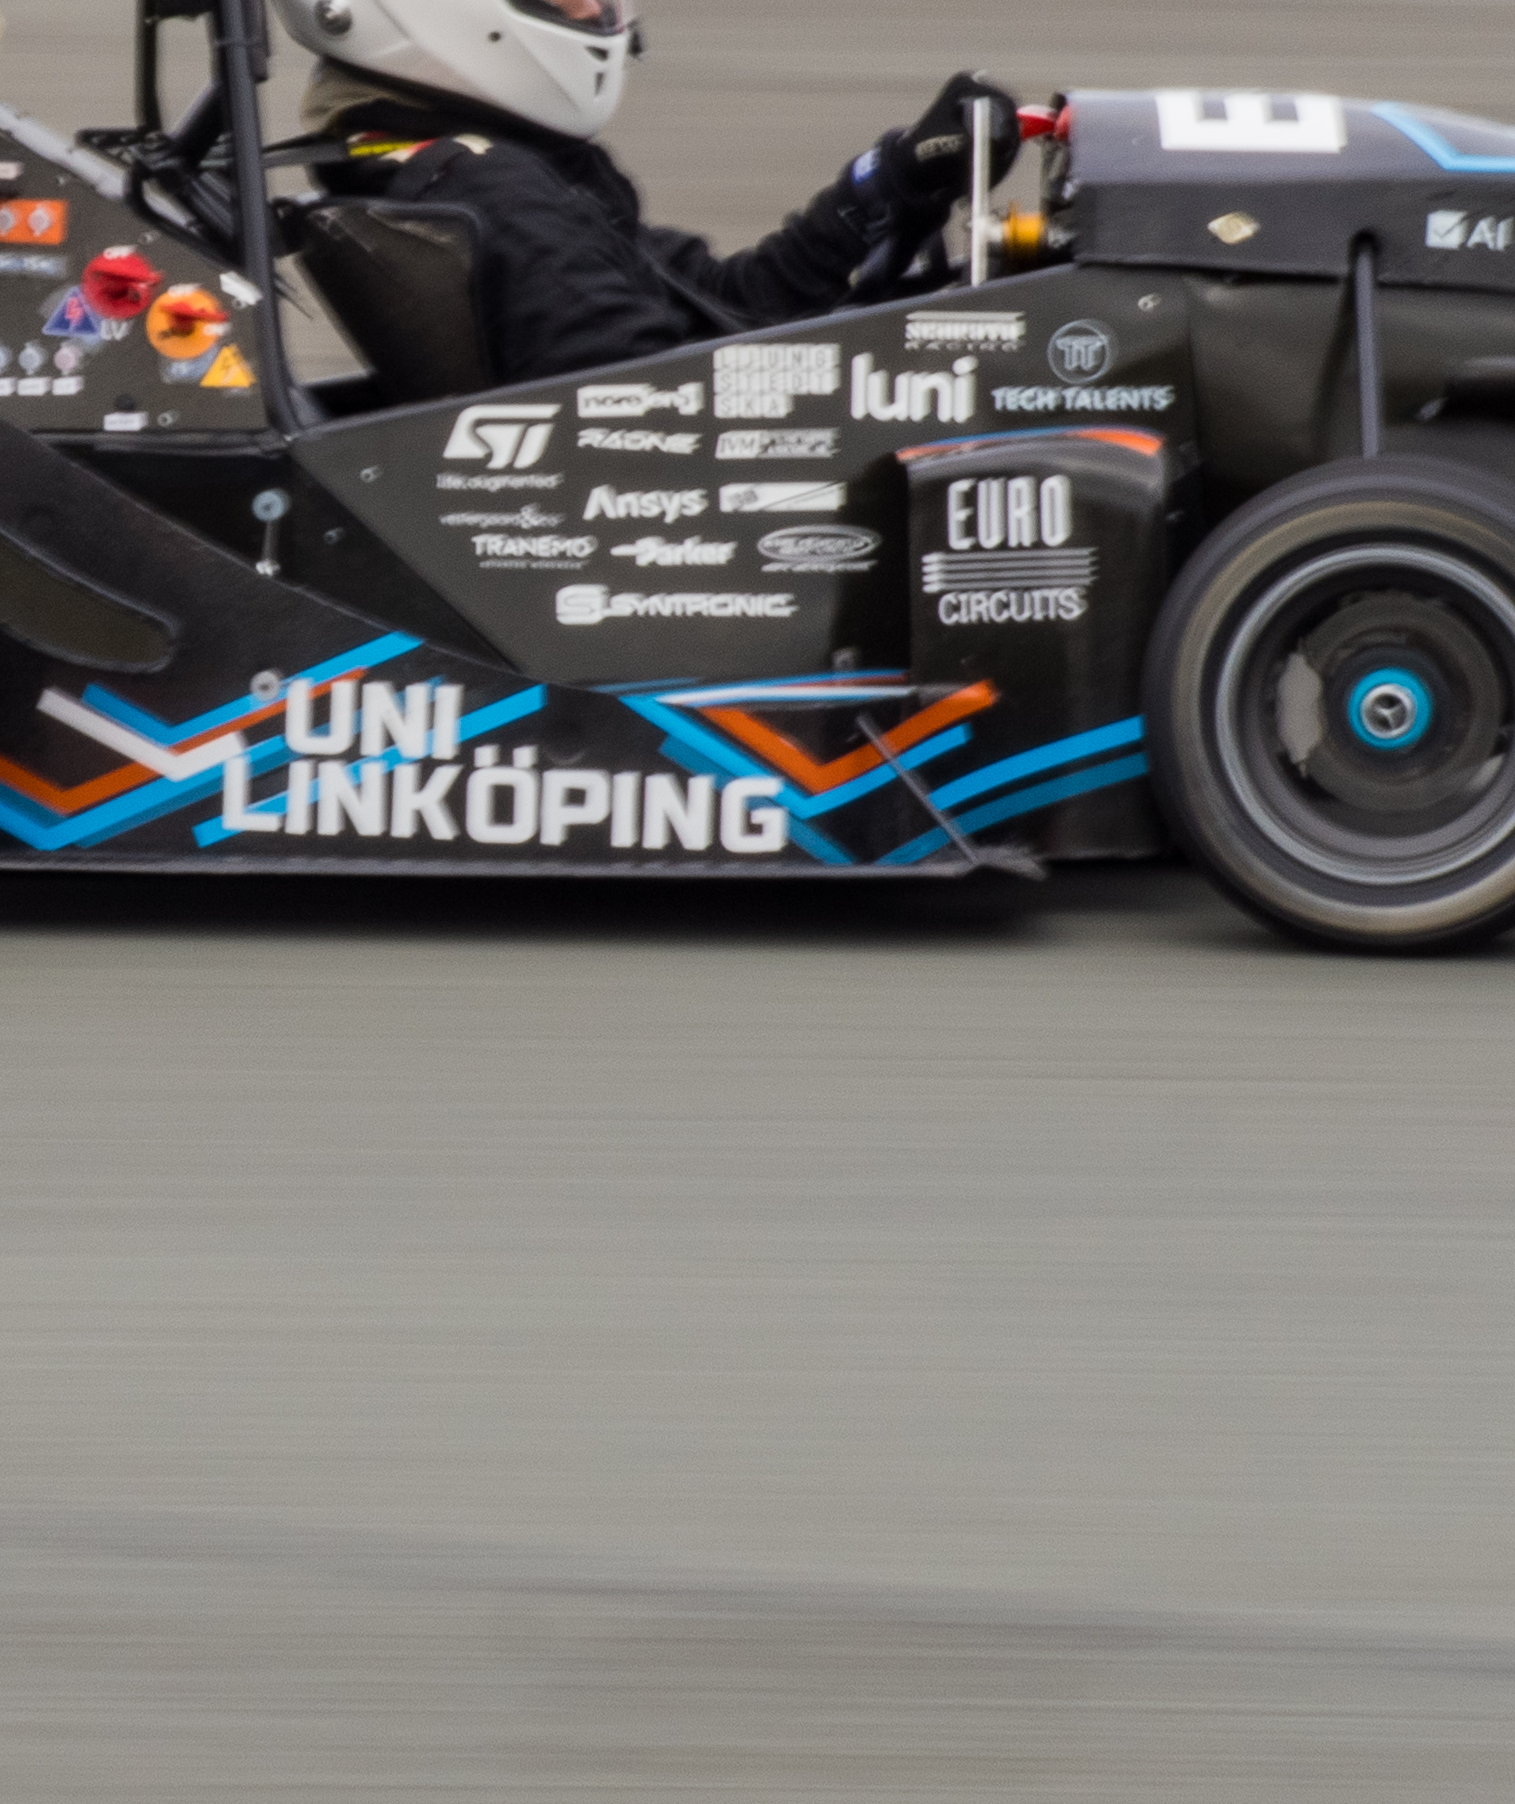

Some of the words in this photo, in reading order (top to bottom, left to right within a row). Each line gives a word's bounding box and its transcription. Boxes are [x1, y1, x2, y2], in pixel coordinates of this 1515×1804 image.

[1467, 217, 1513, 250] AI
[851, 350, 978, 424] luni
[992, 387, 1059, 410] TECH
[1062, 386, 1175, 411] TALENTS
[717, 396, 783, 415] SKA
[578, 428, 701, 455] RADNE
[583, 484, 708, 523] Ansys
[948, 474, 1073, 550] EURO
[472, 533, 598, 557] TRANEMO
[635, 535, 738, 566] Parker
[610, 593, 799, 617] SYNTRONIC
[938, 586, 1089, 625] CIRCUITS
[286, 678, 462, 760] UNI
[221, 744, 788, 854] LINKÖPING
